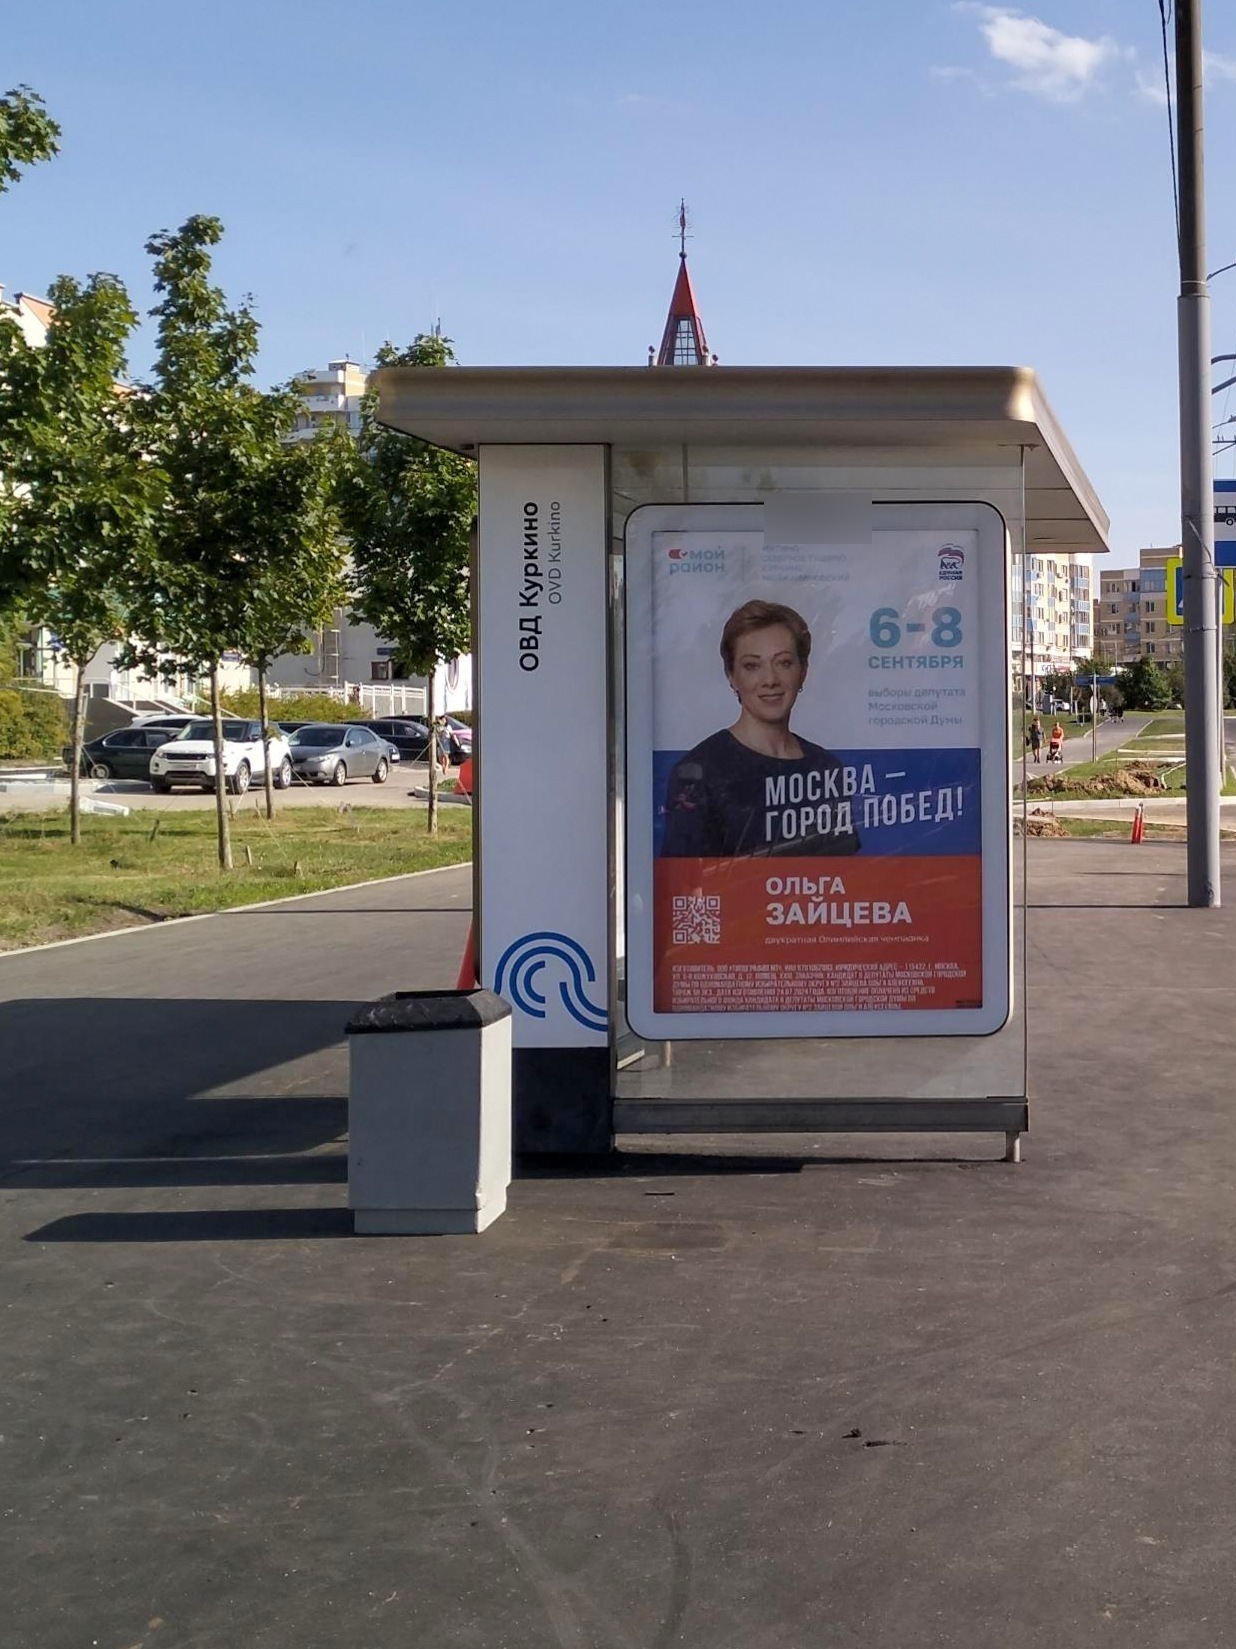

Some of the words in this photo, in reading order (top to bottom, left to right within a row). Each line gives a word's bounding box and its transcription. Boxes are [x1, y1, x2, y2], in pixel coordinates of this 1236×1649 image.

[547, 501, 561, 563] Kurkino
[519, 501, 543, 607] Куркино
[548, 568, 562, 604] OVD
[519, 615, 542, 672] ОВД
[868, 655, 964, 670] СЕНТЯБРЯ
[868, 687, 912, 699] выборы
[914, 688, 966, 699] депутата
[868, 701, 938, 711] Московской
[868, 715, 928, 727] городской
[930, 714, 963, 726] Думы
[765, 763, 876, 807] МОСКВА
[765, 800, 854, 842] ГОРОД
[863, 787, 964, 829] ПОБЕД!
[765, 876, 846, 896] ОЛЬГА
[765, 896, 912, 927] ЗАЙЦЕВА
[765, 936, 816, 945] двукратная
